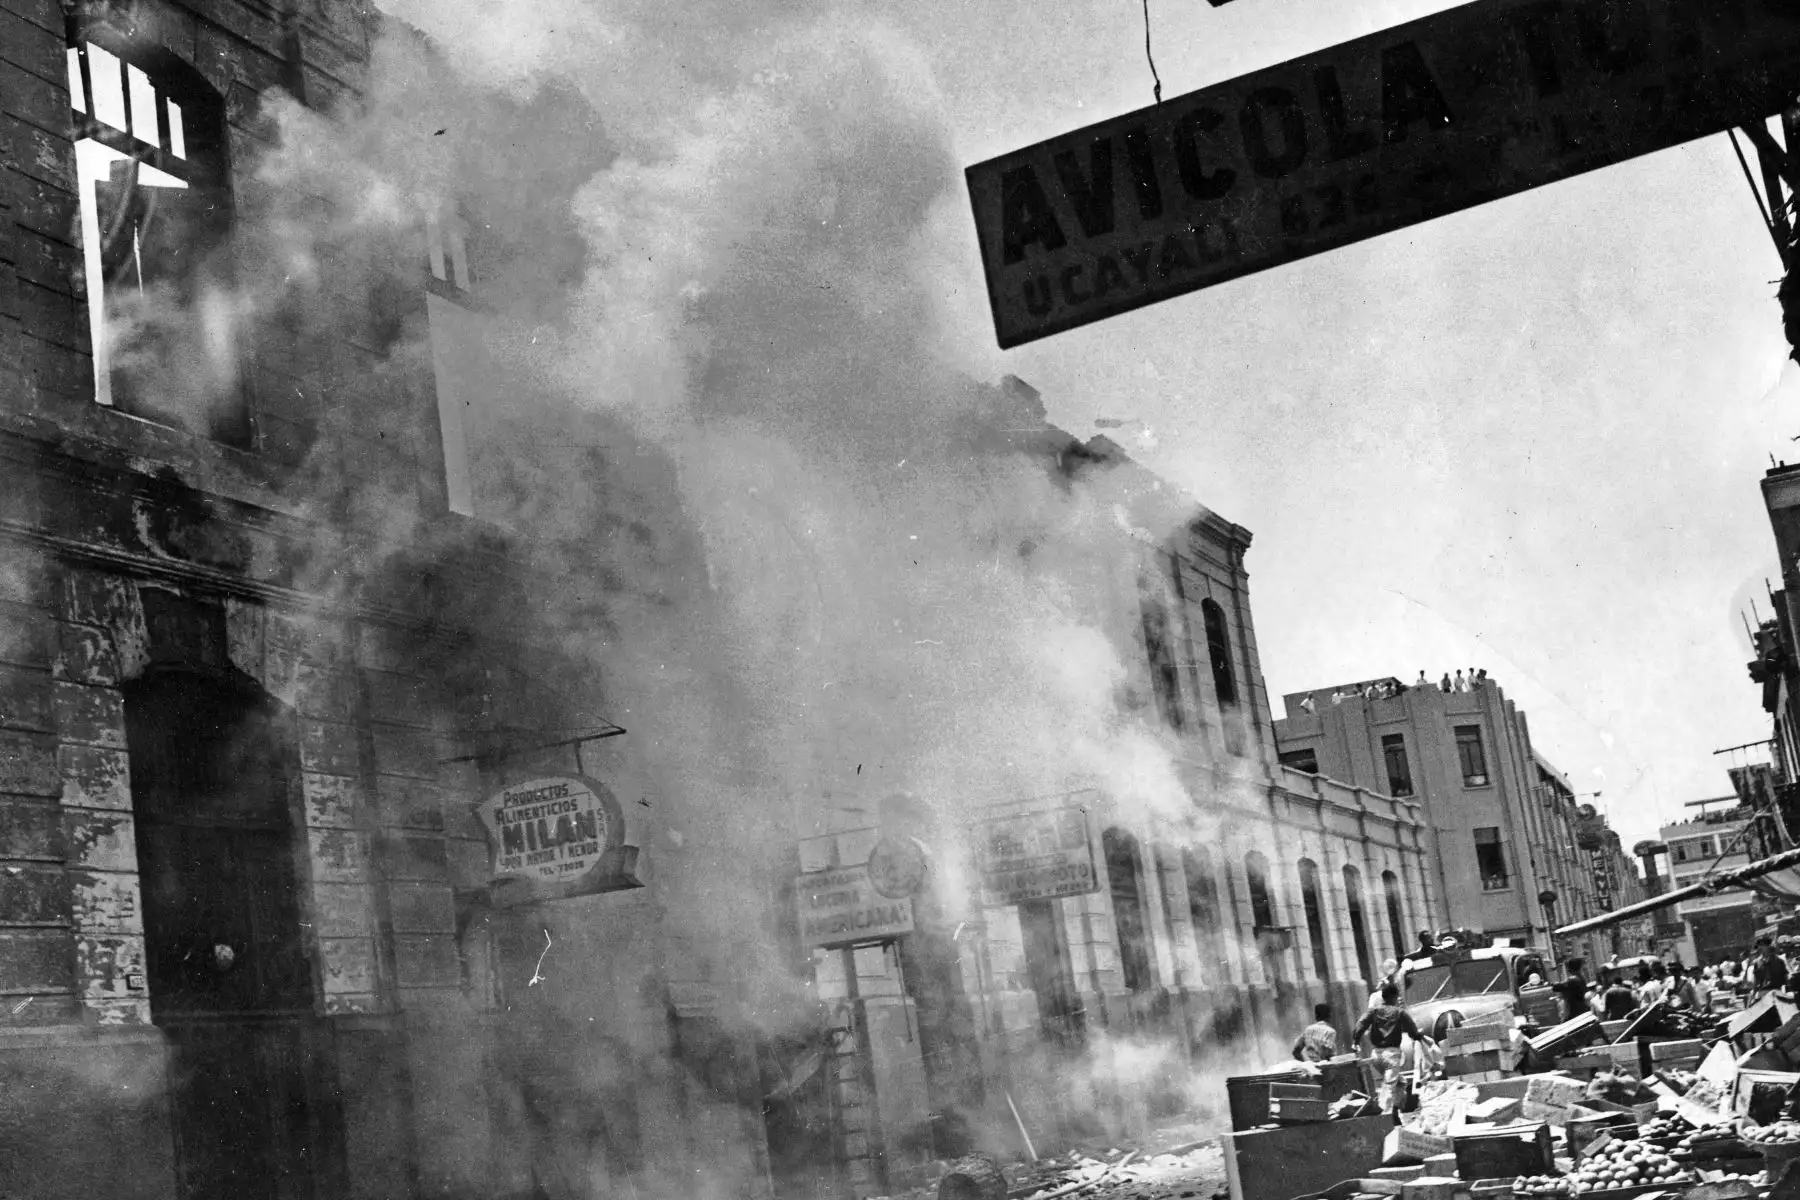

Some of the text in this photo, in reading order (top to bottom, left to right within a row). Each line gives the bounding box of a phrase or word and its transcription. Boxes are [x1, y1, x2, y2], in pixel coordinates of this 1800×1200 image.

[1001, 40, 1456, 265] AVICOLA
[494, 798, 578, 826] ALIMENTICIOS
[503, 783, 569, 807] PRODUCTOS
[503, 810, 598, 856] MILAN
